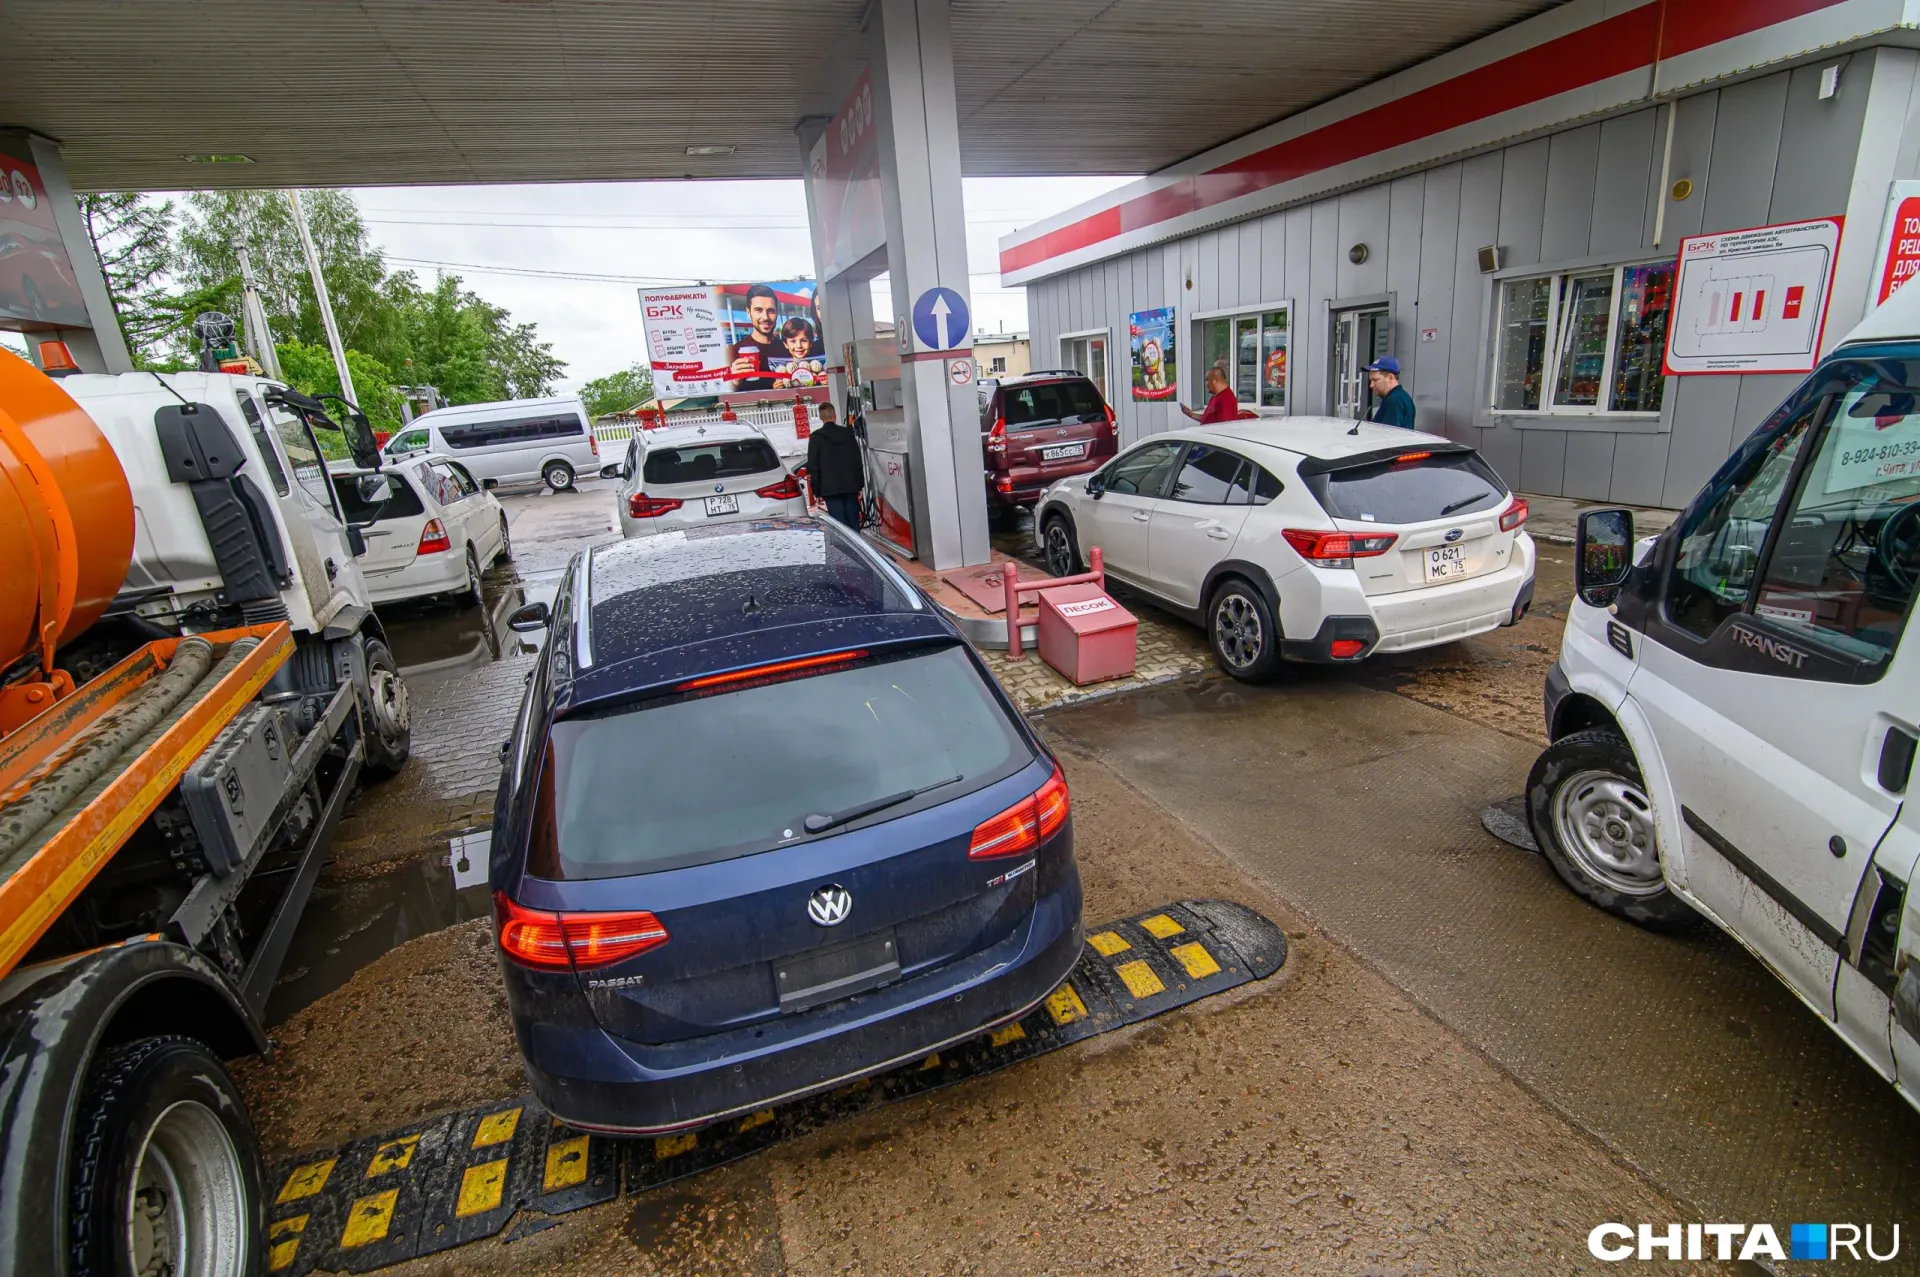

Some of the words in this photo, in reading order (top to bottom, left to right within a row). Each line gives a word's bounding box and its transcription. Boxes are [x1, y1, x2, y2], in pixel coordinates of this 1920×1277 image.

[15, 179, 32, 199] 92
[1774, 223, 1829, 235] АВТОТРАНСПОРТА
[1687, 241, 1716, 252] БРК
[1892, 259, 1920, 279] ДЛЯ
[645, 293, 707, 302] ПОЛУФАБРИКАТЫ
[646, 304, 683, 317] БРК
[900, 320, 907, 345] 2
[1442, 548, 1459, 560] 621
[1431, 565, 1447, 577] МС
[1454, 560, 1463, 569] 75
[1064, 600, 1108, 613] ПЕСОК
[1731, 624, 1809, 669] TRANSIT
[588, 975, 643, 988] PASSAT
